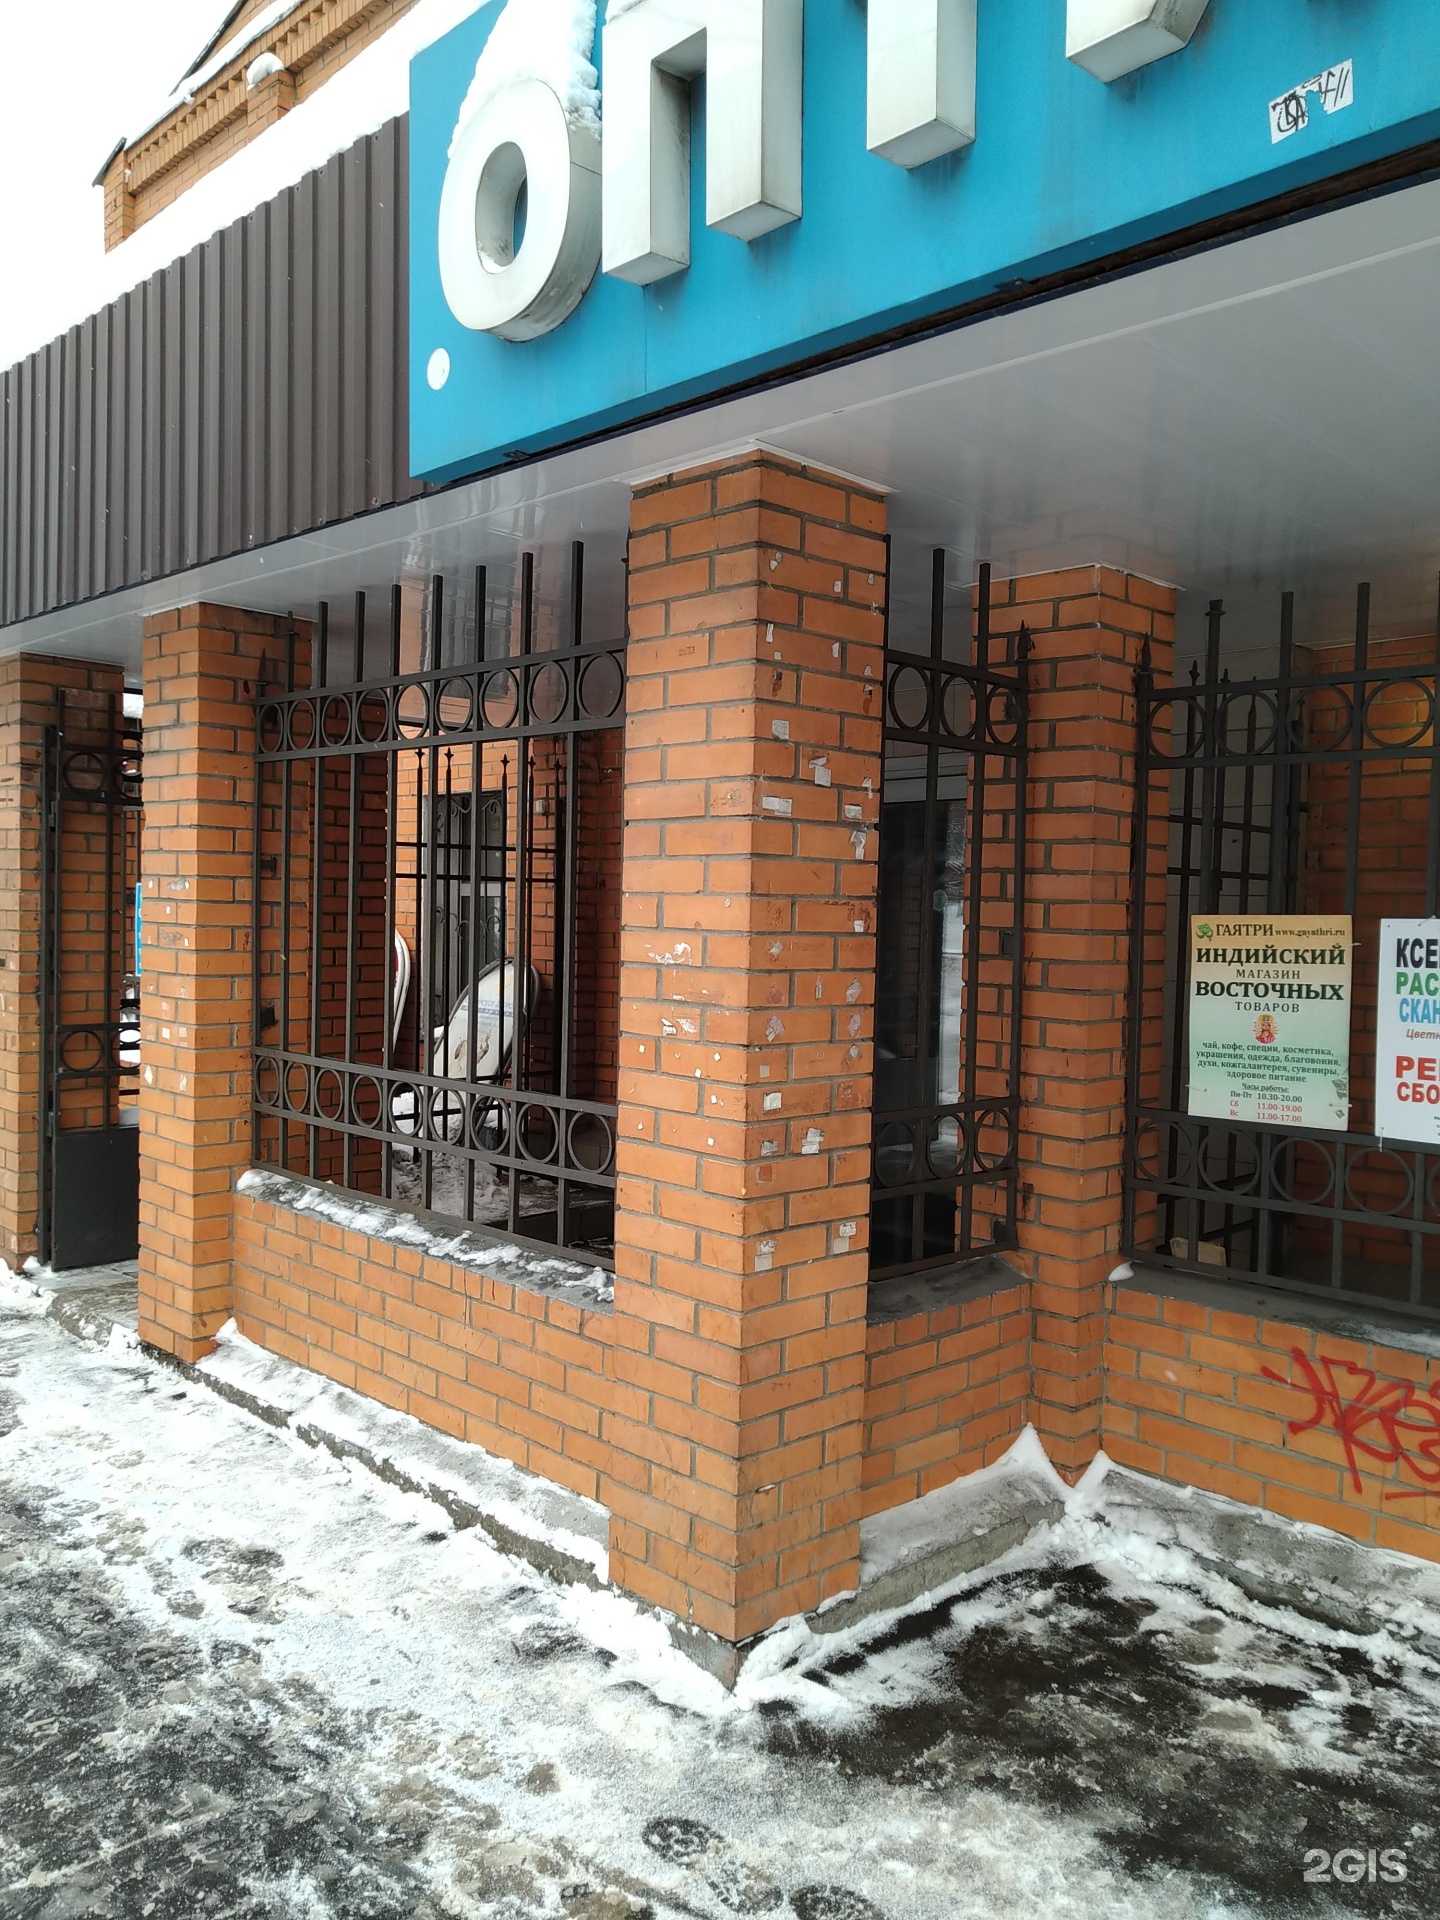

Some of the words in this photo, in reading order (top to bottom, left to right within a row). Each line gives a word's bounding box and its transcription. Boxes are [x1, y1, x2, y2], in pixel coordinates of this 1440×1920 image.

[1216, 924, 1273, 936] ГАЯТРИ
[1196, 943, 1346, 966] ИНДИЙСКИЙ
[1396, 937, 1440, 969] КСЕ
[1235, 969, 1301, 979] МАГАЗИН
[1195, 981, 1345, 1001] ВОСТОЧНЫХ
[1235, 1001, 1300, 1013] ТОВАРОВ
[1202, 1041, 1219, 1050] чай,
[1222, 1042, 1245, 1053] кофе,
[1246, 1044, 1281, 1054] специи,
[1282, 1046, 1334, 1057] косметика,
[1196, 1050, 1246, 1060] украшения,
[1247, 1054, 1282, 1063] одежда,
[1284, 1056, 1341, 1067] благовония,
[1197, 1060, 1219, 1069] духи,
[1291, 1065, 1340, 1077] сувениры,
[1395, 1056, 1440, 1081] РЕ
[1226, 1071, 1266, 1080] здоровое
[1268, 1073, 1307, 1083] питание
[1242, 1083, 1259, 1091] Часы
[1230, 1091, 1252, 1099] Пн-Пт
[1257, 1092, 1303, 1103] 10.30-20.00
[1230, 1099, 1239, 1107] Сб
